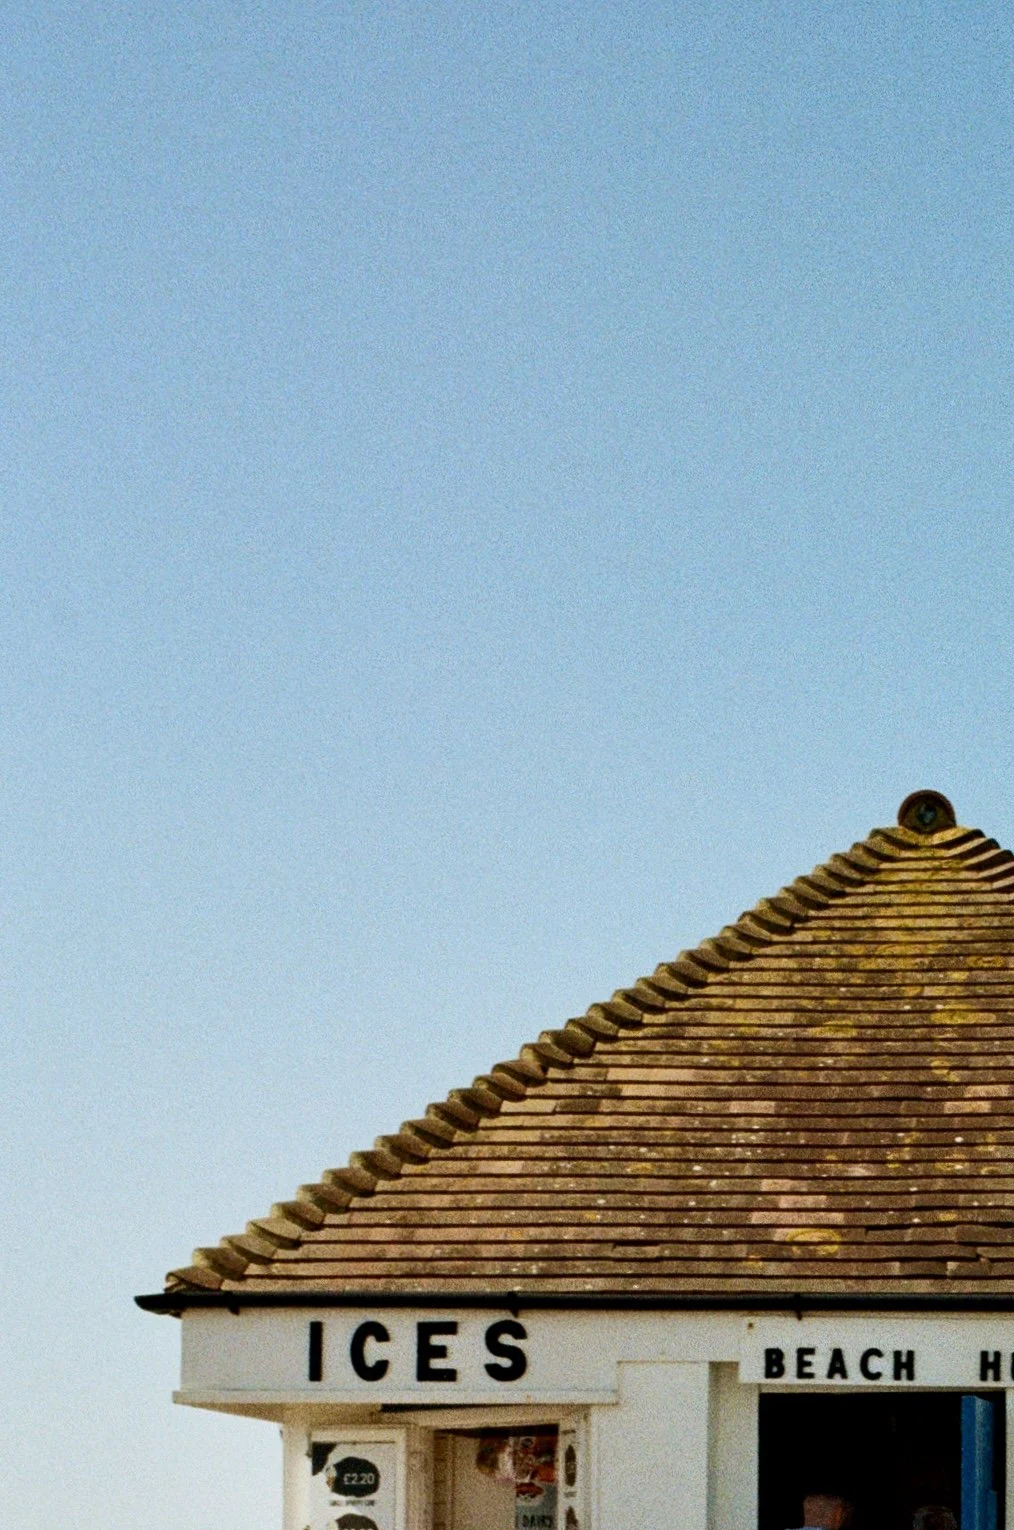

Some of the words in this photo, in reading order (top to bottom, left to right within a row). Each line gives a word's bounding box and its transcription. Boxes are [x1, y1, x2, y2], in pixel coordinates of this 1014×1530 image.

[308, 1320, 528, 1383] ICES
[764, 1347, 915, 1381] BEACH
[343, 1473, 375, 1485] £2.20
